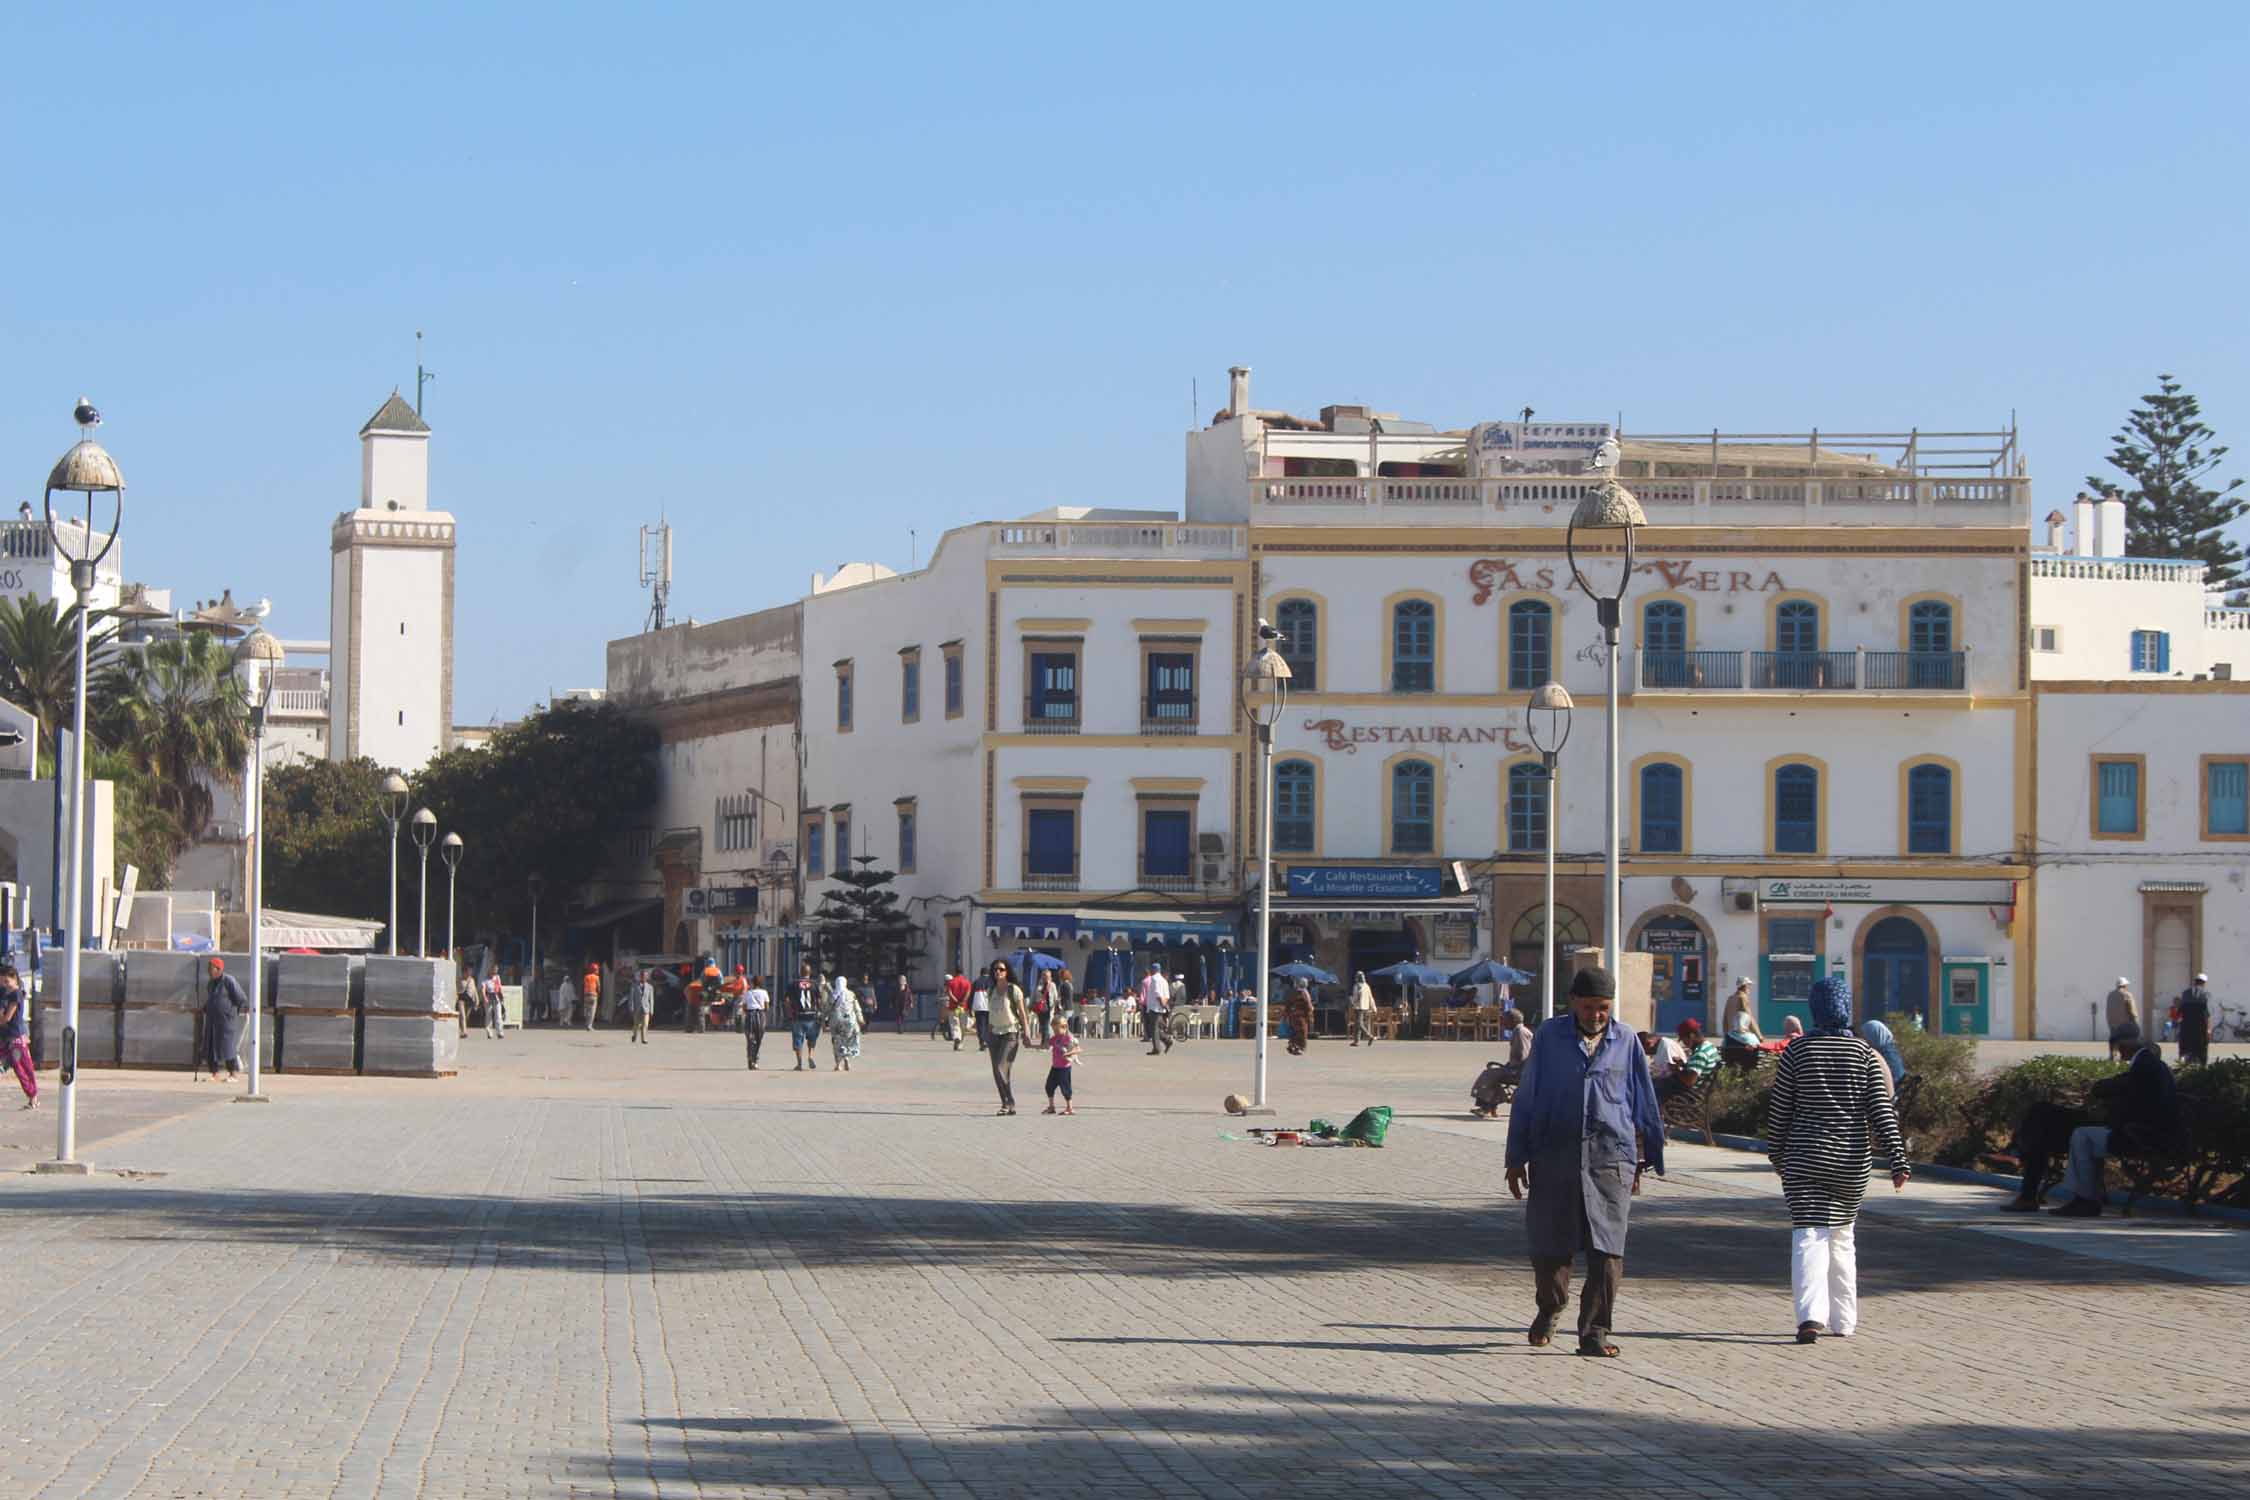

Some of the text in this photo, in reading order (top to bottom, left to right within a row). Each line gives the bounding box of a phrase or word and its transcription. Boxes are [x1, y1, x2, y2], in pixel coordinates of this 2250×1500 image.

[0, 569, 24, 590] OS
[1469, 559, 1787, 606] CASA VERA
[1304, 719, 1532, 754] RESTAURANT
[1350, 871, 1403, 881] Restaurant
